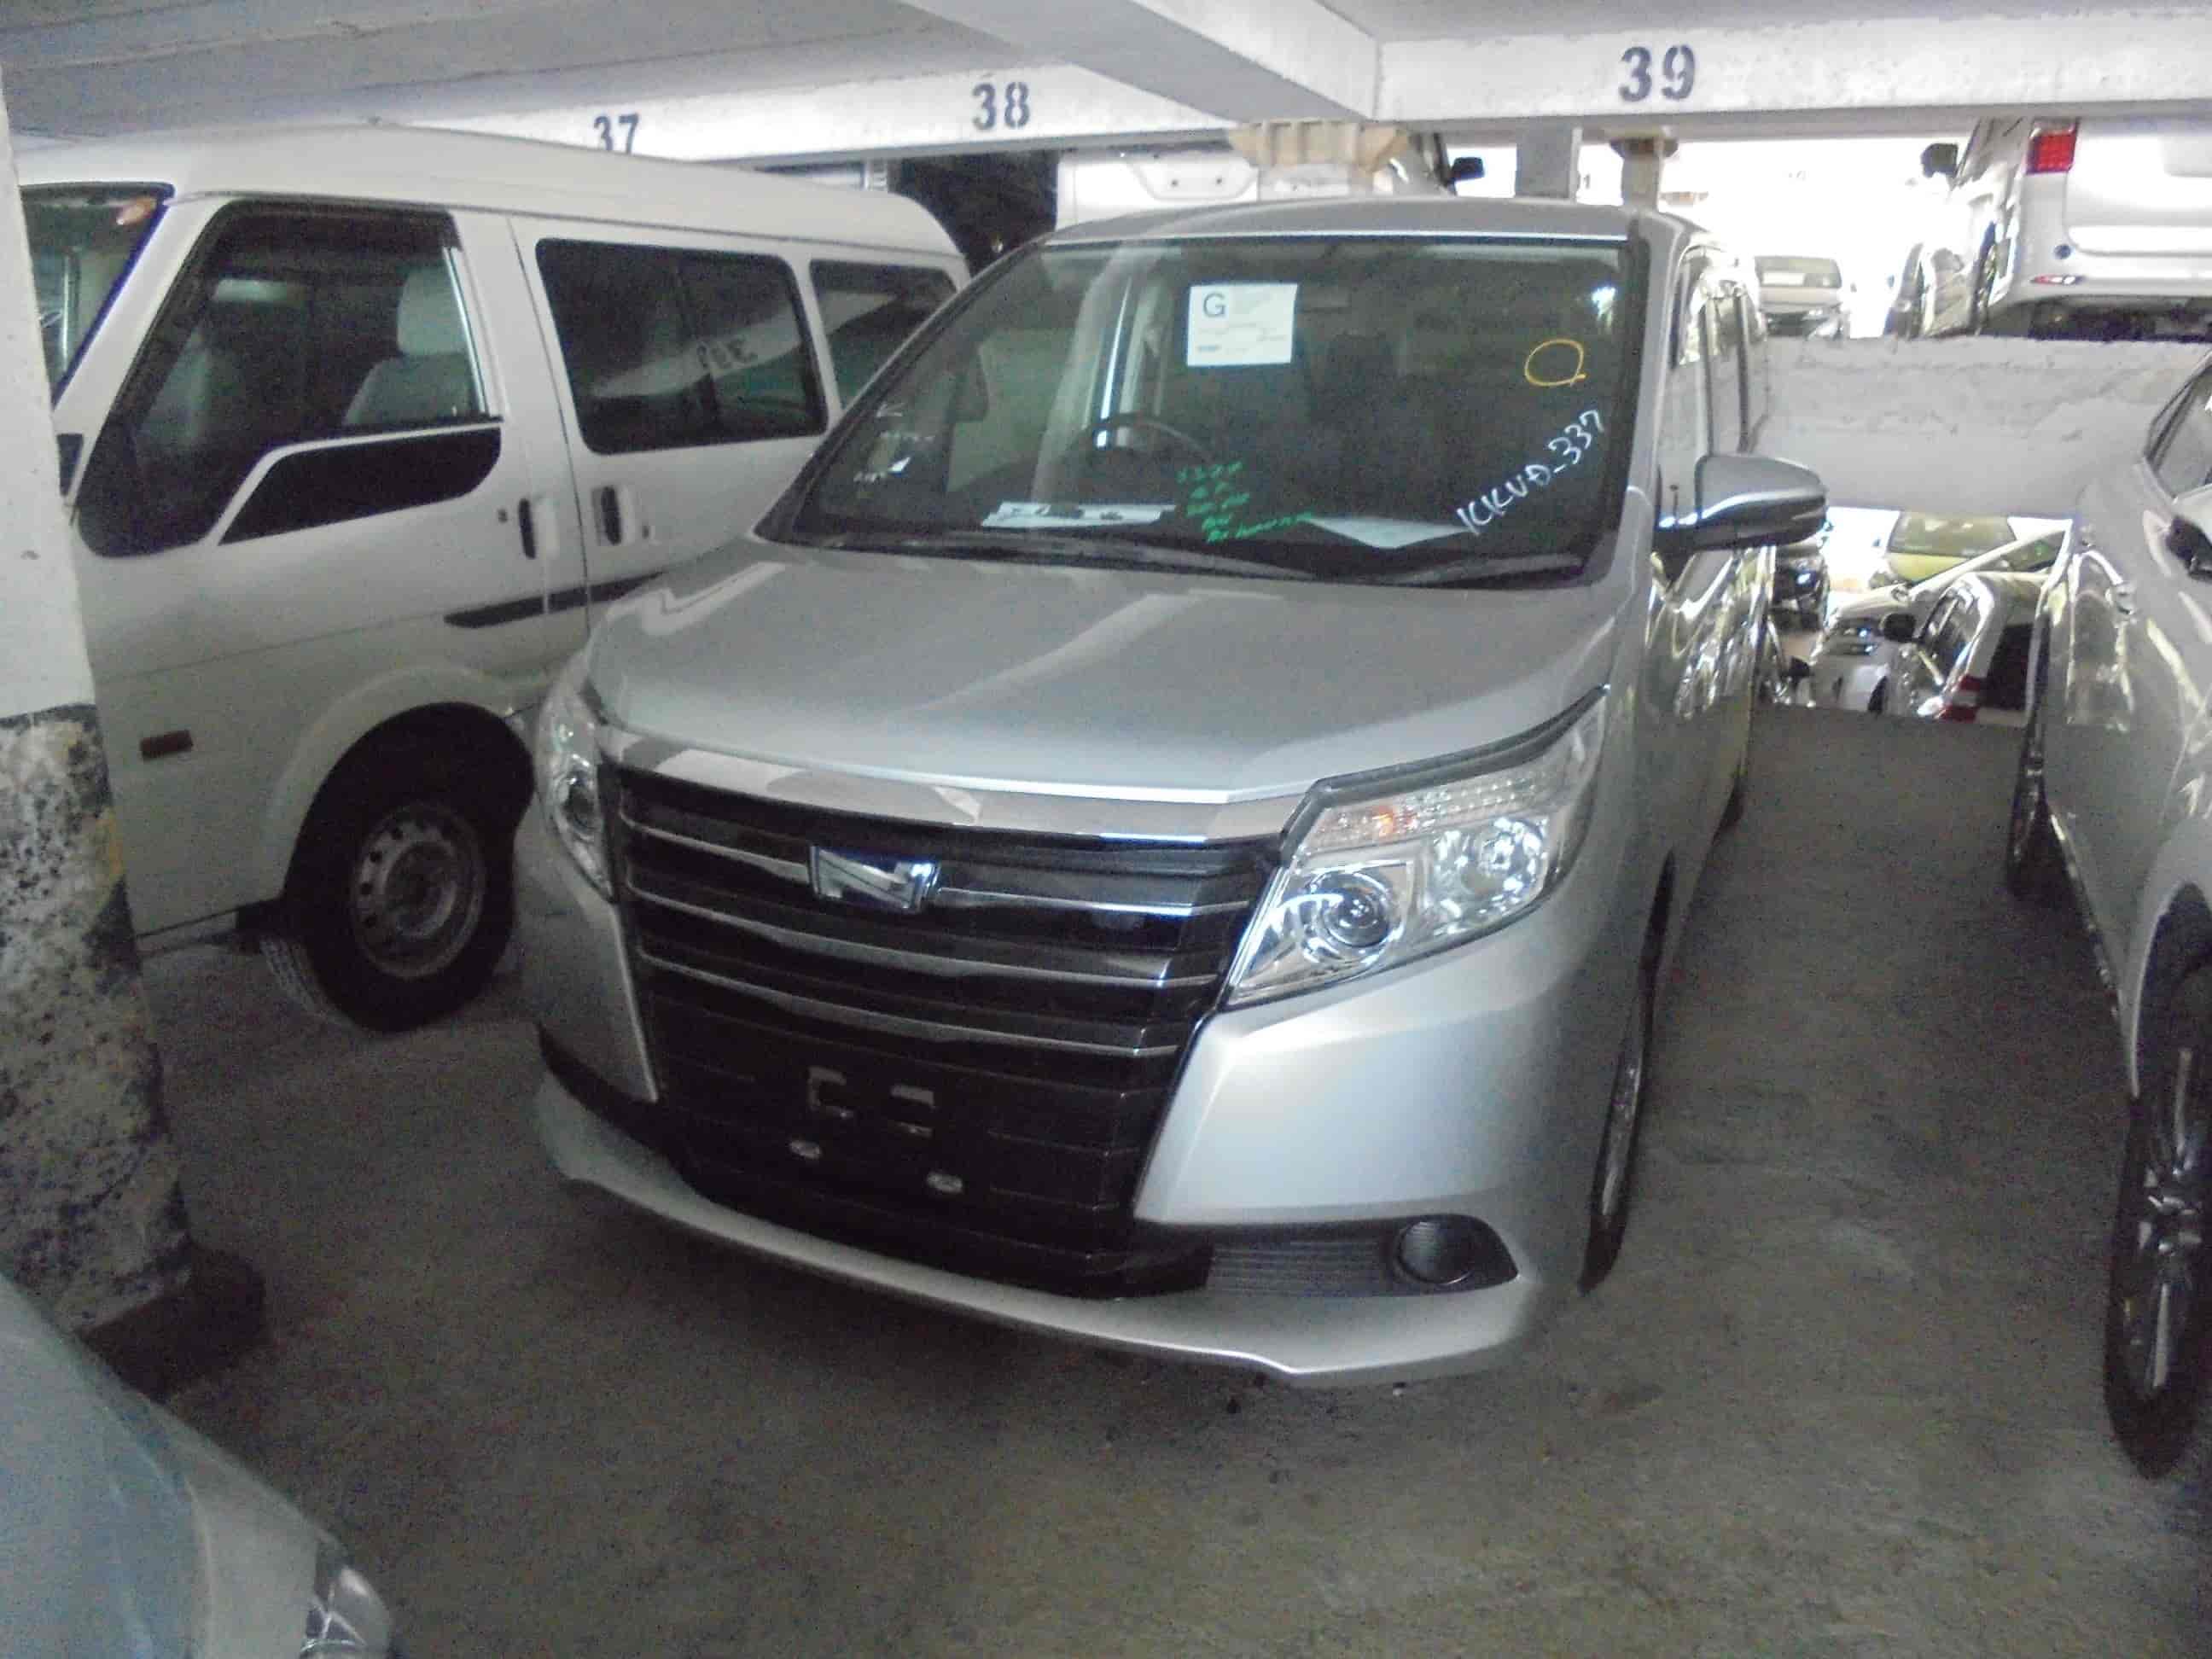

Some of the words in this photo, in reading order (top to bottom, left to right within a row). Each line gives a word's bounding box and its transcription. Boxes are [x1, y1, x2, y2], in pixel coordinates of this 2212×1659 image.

[1618, 45, 1695, 102] 39
[972, 82, 1029, 130] 38
[593, 112, 639, 154] 37
[1202, 292, 1225, 317] G
